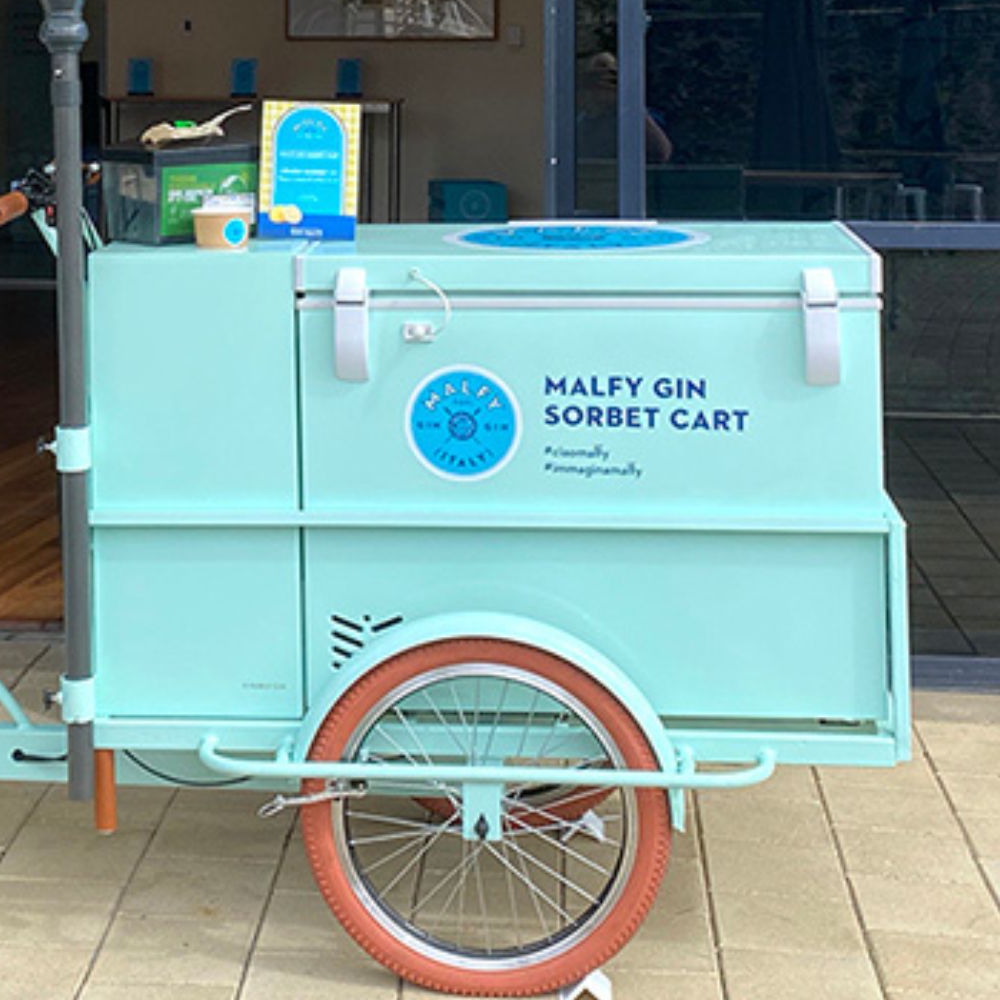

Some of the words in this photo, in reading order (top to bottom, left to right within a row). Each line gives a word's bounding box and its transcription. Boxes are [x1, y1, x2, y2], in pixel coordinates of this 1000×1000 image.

[421, 379, 506, 411] MALFY
[544, 375, 644, 398] MALFY
[653, 377, 707, 400] GIN
[544, 404, 661, 429] SORBET
[669, 408, 750, 432] CART
